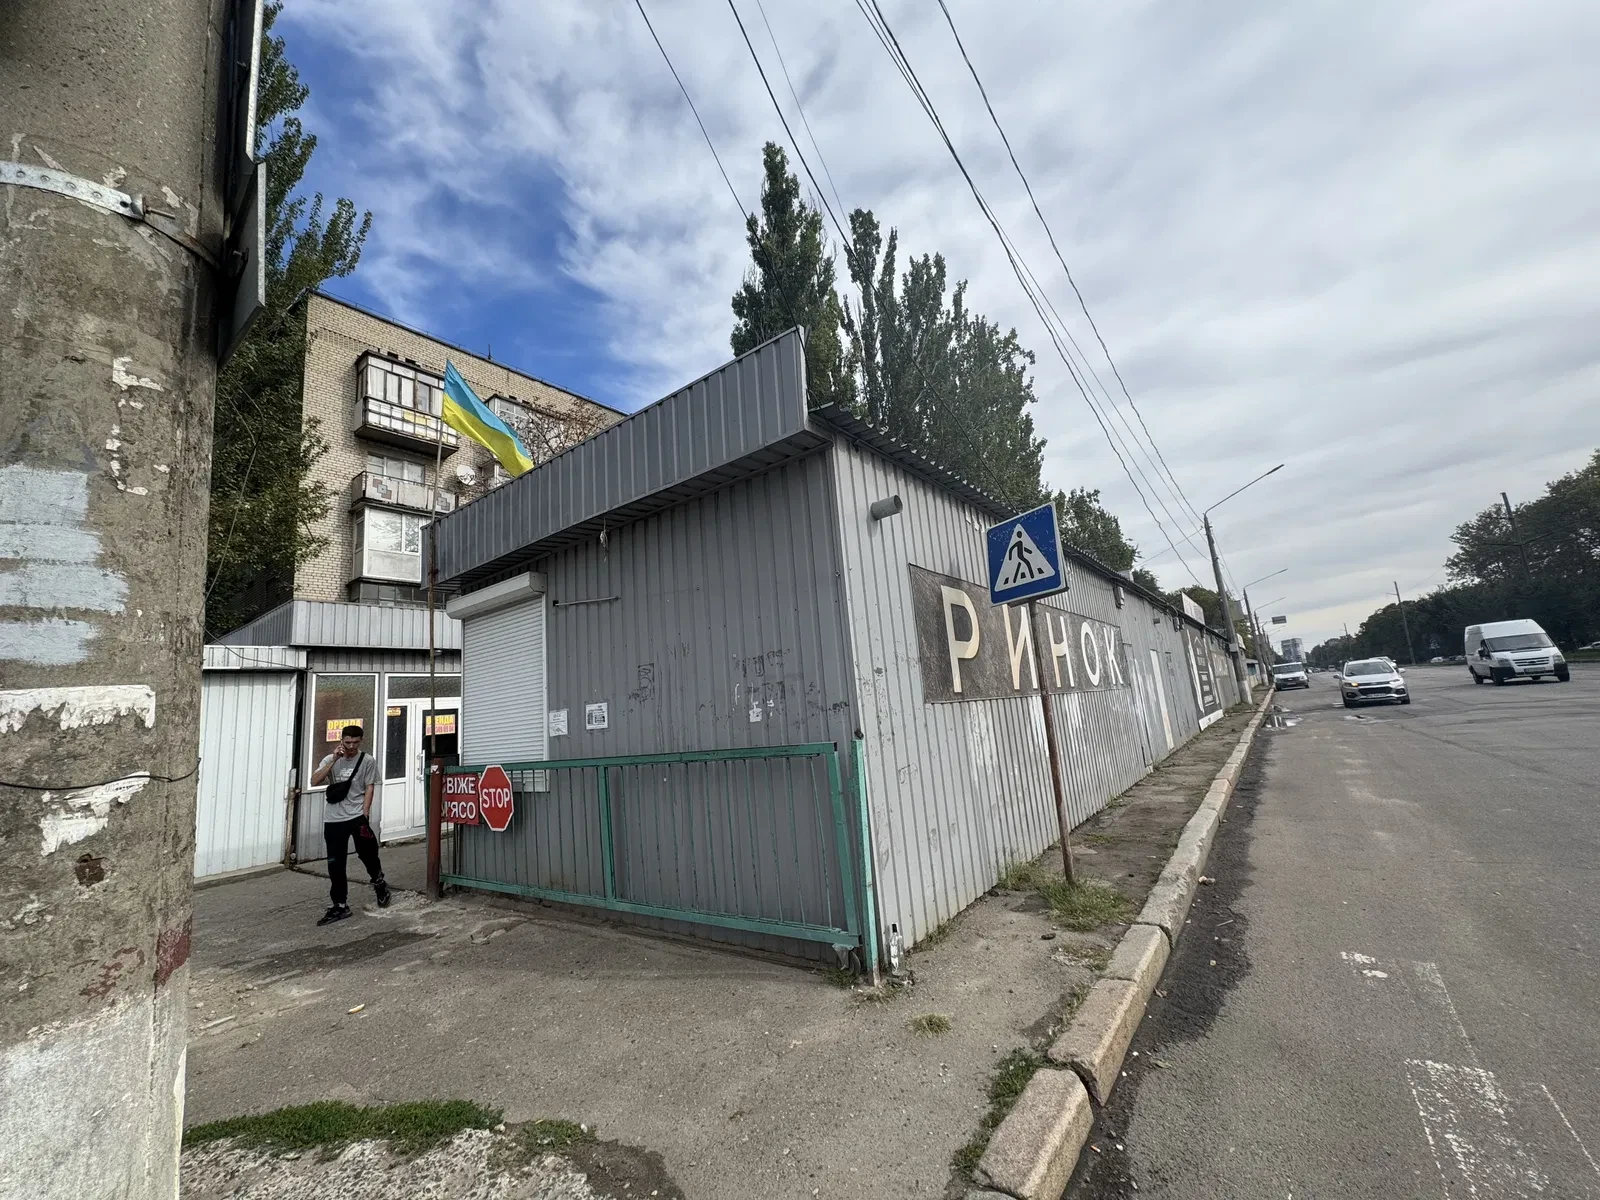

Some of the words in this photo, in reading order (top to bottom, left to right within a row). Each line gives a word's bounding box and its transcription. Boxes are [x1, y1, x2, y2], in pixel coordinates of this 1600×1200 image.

[940, 584, 1125, 694] РИНОК
[426, 715, 454, 726] ОЕНДА
[482, 788, 511, 808] STOP
